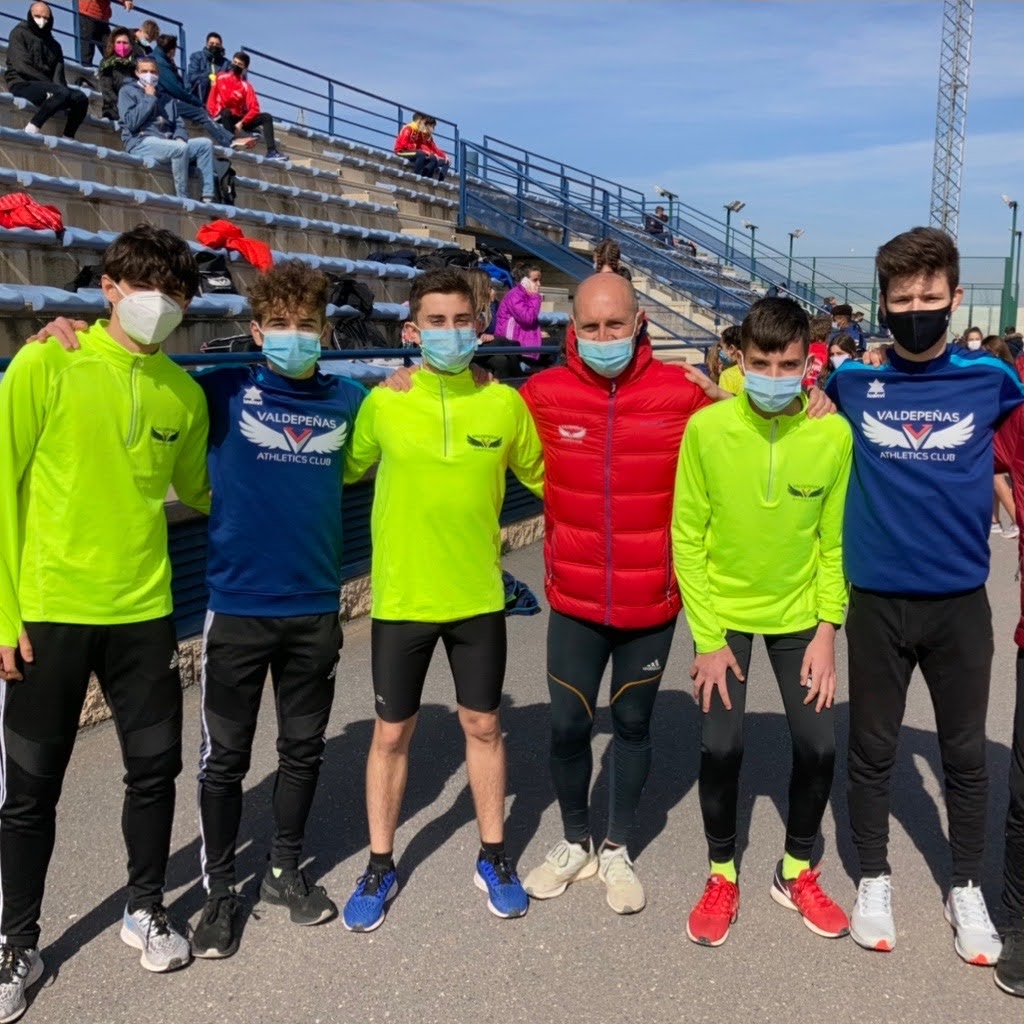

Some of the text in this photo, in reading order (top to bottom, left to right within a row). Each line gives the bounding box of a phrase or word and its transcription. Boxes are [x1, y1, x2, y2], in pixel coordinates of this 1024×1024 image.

[257, 411, 336, 429] VALDEPEÑAS
[877, 410, 960, 422] VALDEPEÑAS
[256, 452, 332, 466] ATHLETICS CLUB
[880, 451, 956, 462] ATHLETICS CLUB
